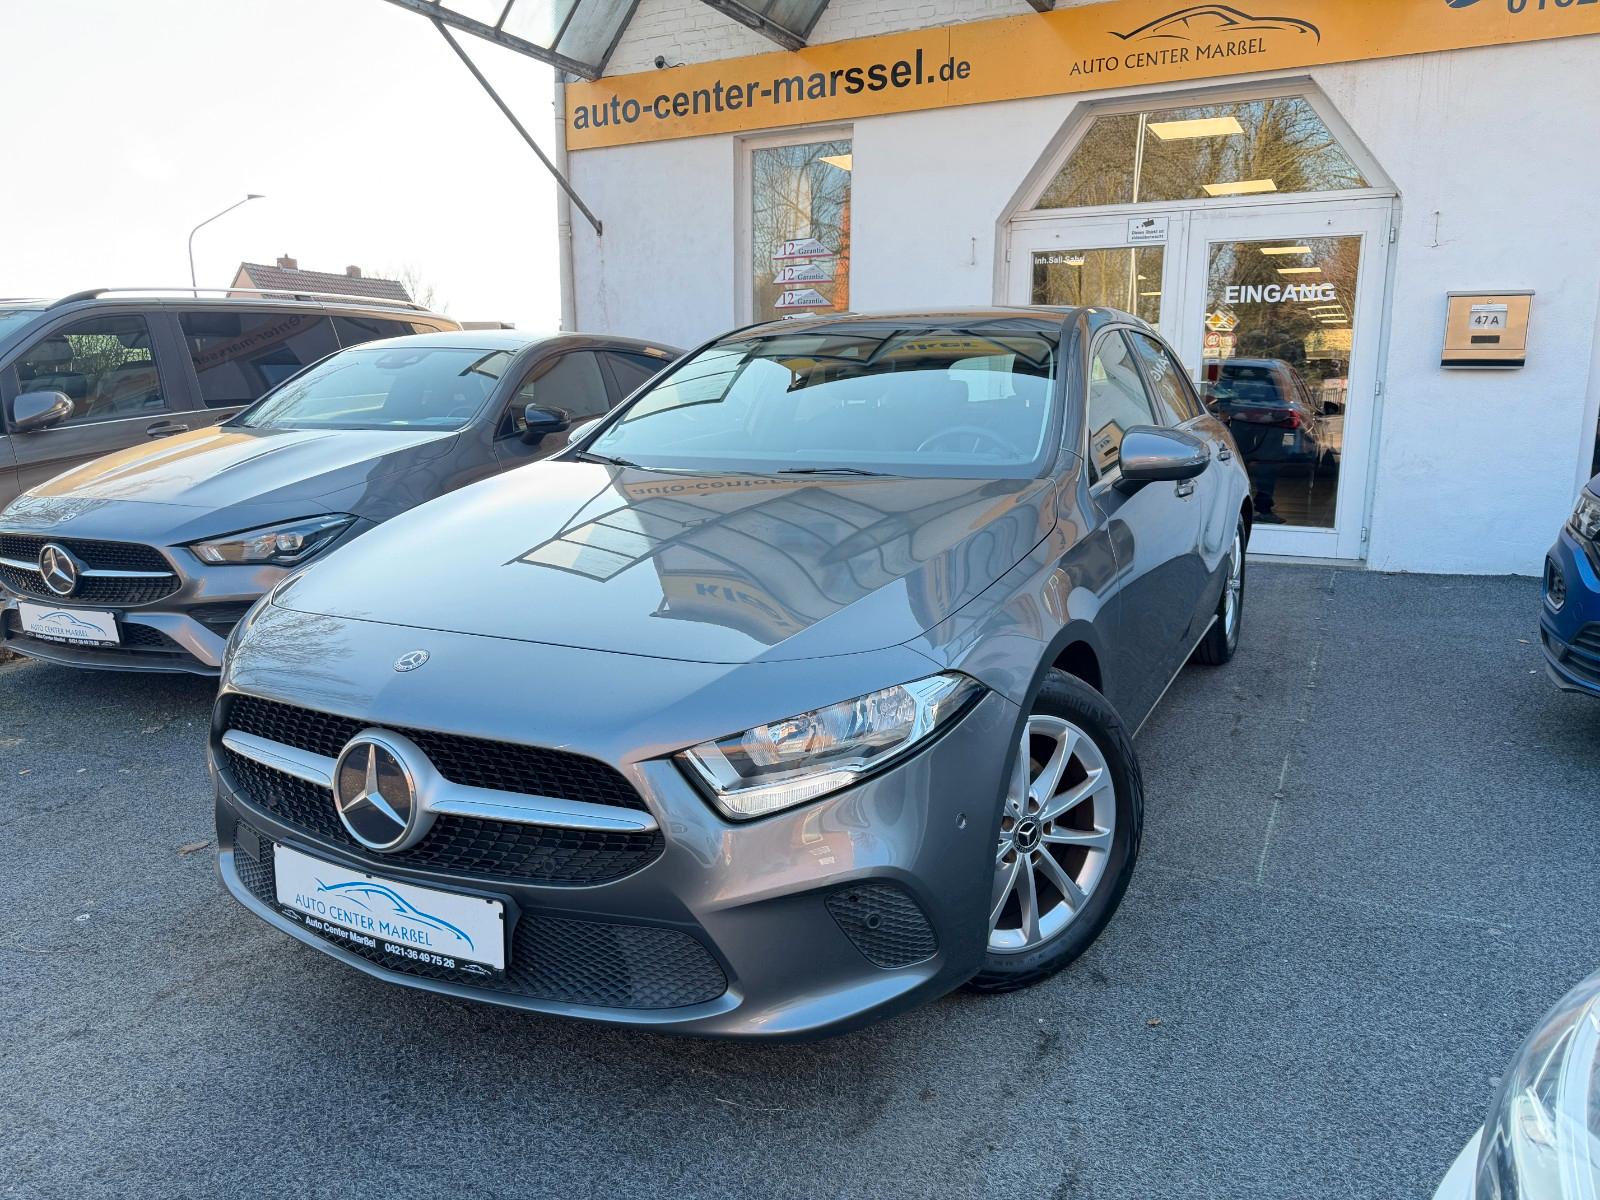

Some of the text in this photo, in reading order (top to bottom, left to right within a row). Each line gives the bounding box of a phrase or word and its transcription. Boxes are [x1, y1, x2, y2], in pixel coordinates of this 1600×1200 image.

[1069, 56, 1119, 76] AUTO
[1124, 48, 1189, 69] CENTER
[573, 48, 971, 130] auto-center-marssel.de
[783, 242, 825, 256] 12 Garantie
[783, 267, 795, 281] 12
[782, 292, 794, 305] 12
[1225, 282, 1336, 304] EINGANG
[1474, 315, 1499, 325] 47 A
[295, 893, 326, 915] AUTO
[329, 906, 375, 931] CENTER
[305, 916, 323, 930] Auto
[323, 923, 349, 939] Center
[384, 942, 418, 960] 0421-36
[418, 954, 430, 963] 49
[430, 954, 443, 966] 75
[443, 957, 455, 968] 26
